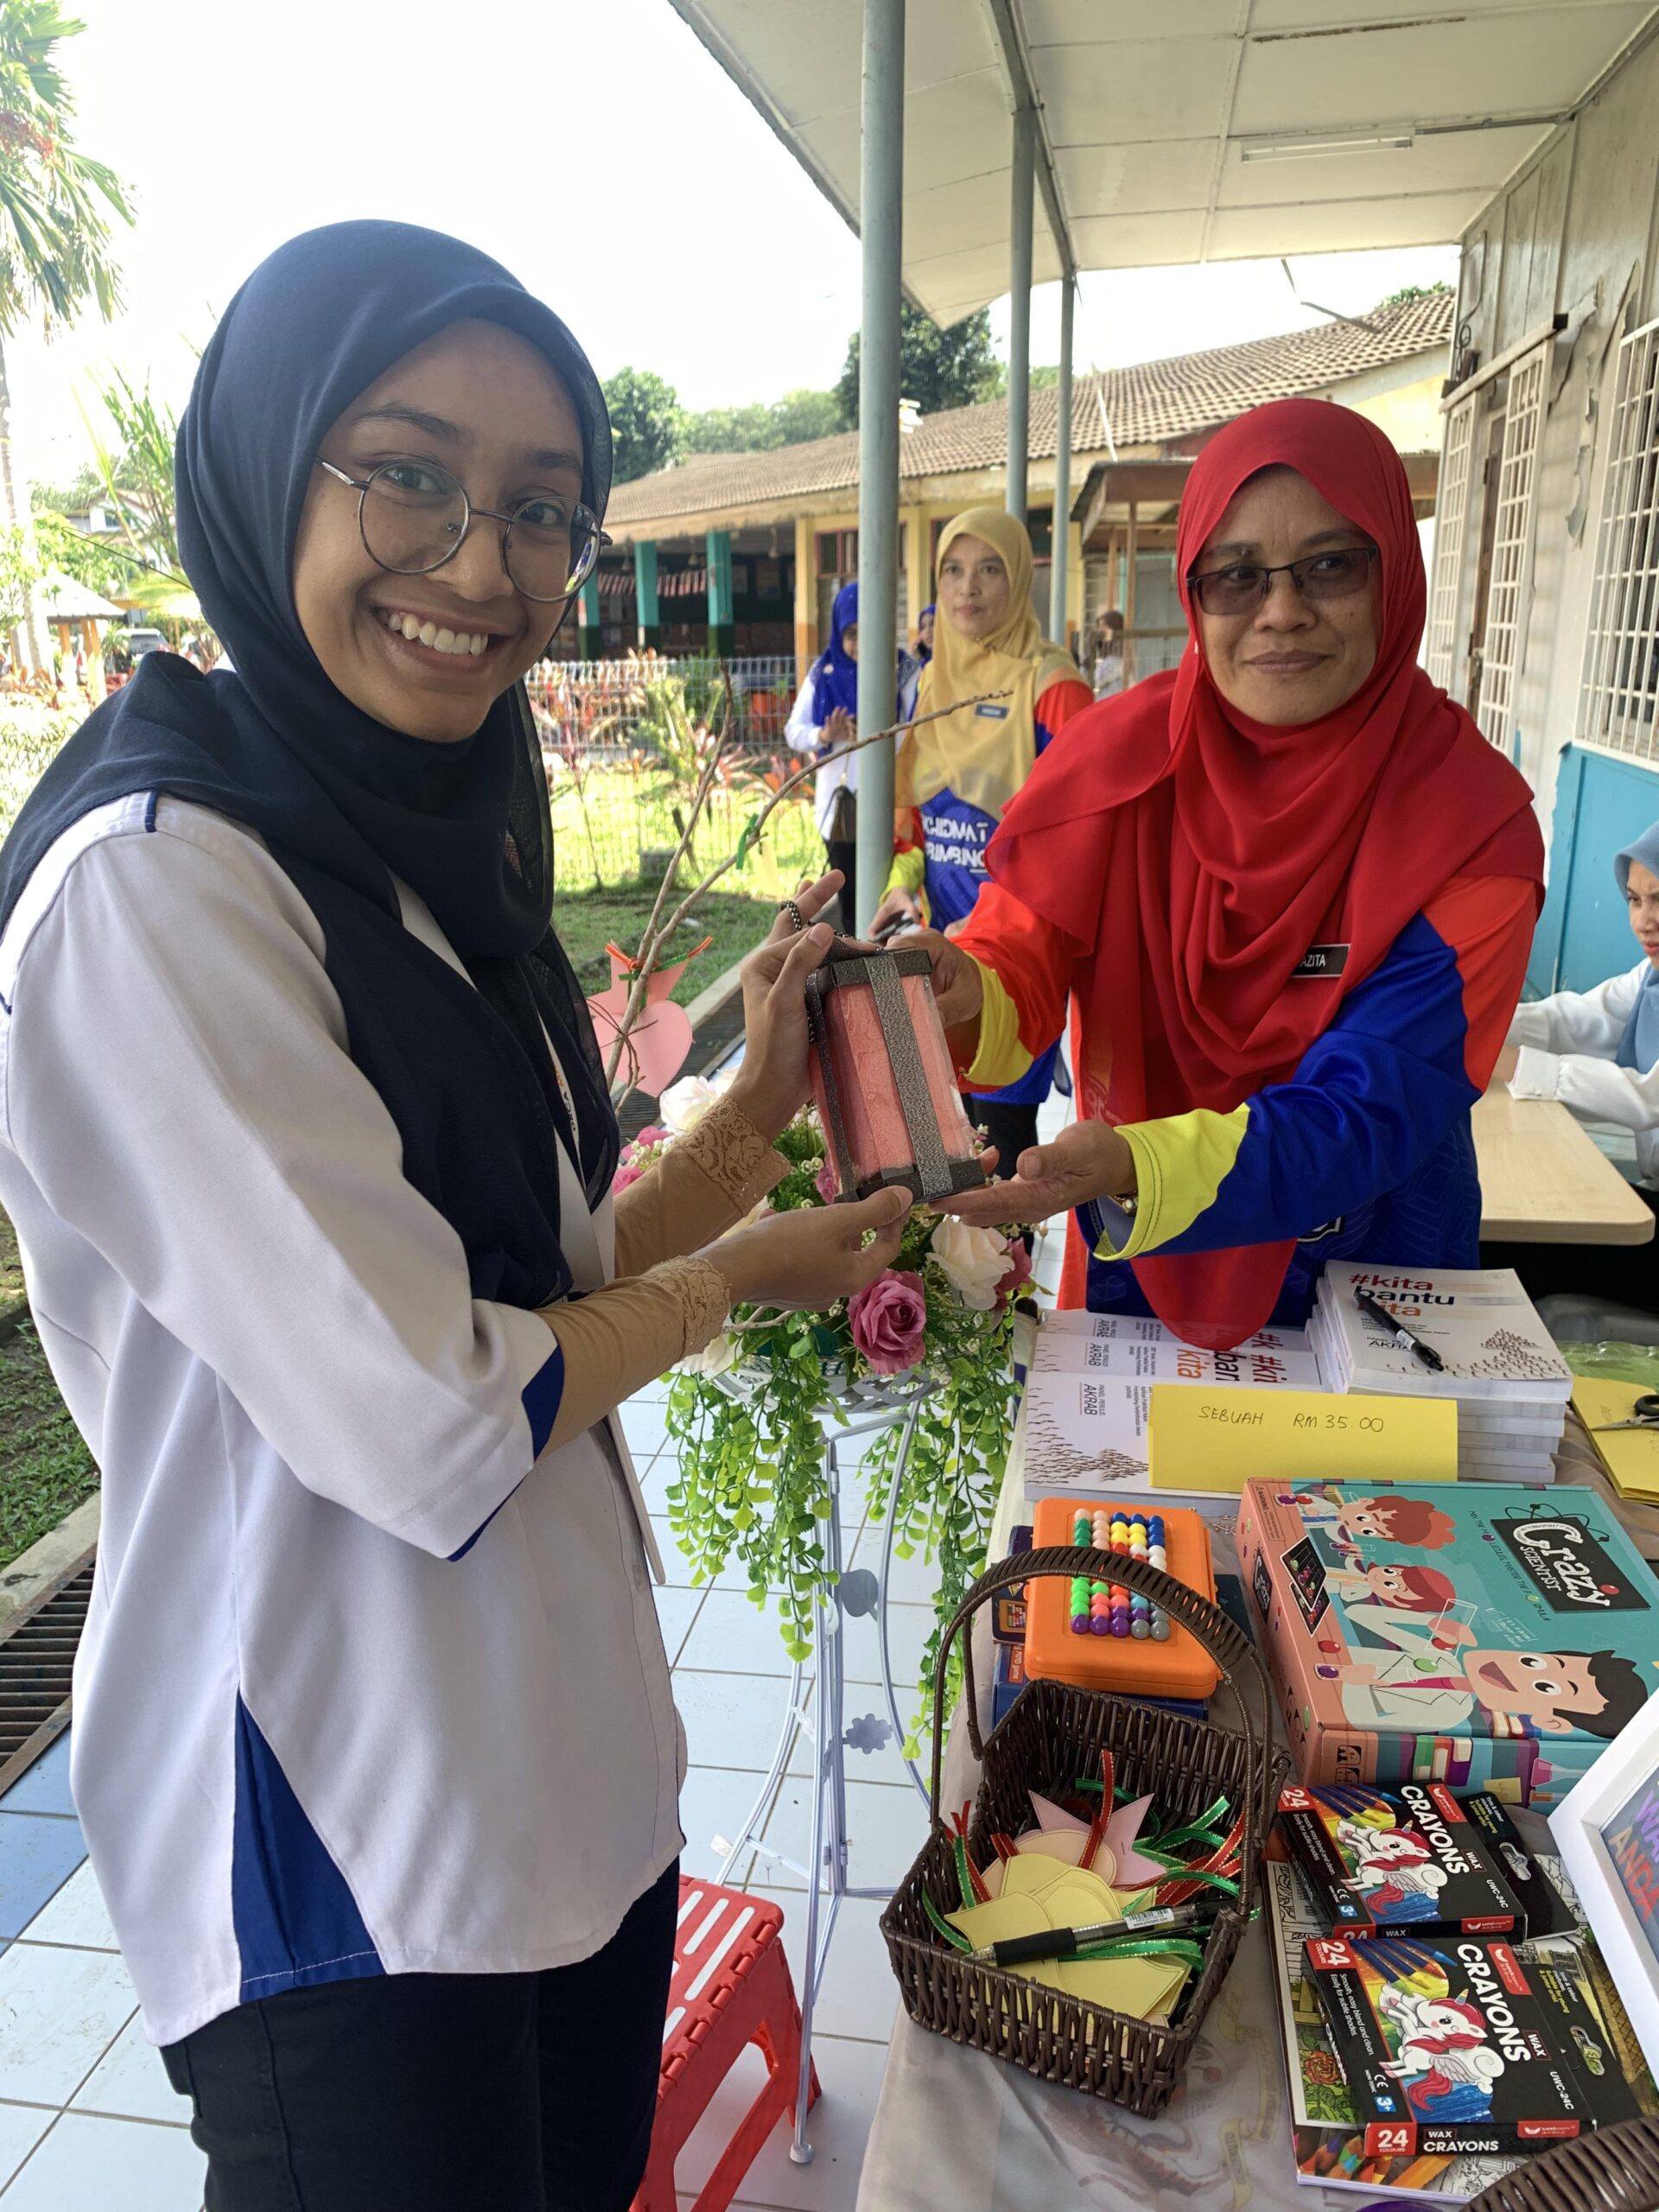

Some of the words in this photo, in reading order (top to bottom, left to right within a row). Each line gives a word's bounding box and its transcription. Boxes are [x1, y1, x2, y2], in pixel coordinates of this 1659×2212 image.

[1349, 1274, 1433, 1291] #kita
[1354, 1286, 1455, 1305] bantu
[1357, 1300, 1421, 1317] ita
[1089, 1343, 1103, 1367] AKRAB
[1177, 1349, 1211, 1379] kita
[1084, 1383, 1098, 1415] AKRAB
[1198, 1405, 1264, 1425] SEBUAH
[1293, 1413, 1318, 1428] RM
[1513, 1522, 1611, 1606] Crazy
[1520, 1546, 1562, 1592] SCIENTIST
[1283, 1789, 1310, 1808] 24
[1401, 1785, 1470, 1874] CRAYONS
[1465, 1852, 1483, 1870] WAX
[1486, 1879, 1509, 1909] UWC-24C
[1340, 1905, 1354, 1916] 3+
[1321, 1942, 1351, 1966] 24
[1348, 1996, 1357, 2009] easy
[1457, 1944, 1532, 2062] CRAYONS
[1353, 2009, 1365, 2026] blend
[1358, 2026, 1370, 2038] and
[1528, 2033, 1547, 2056] WAX
[1550, 2071, 1574, 2111] UWC-24C
[1376, 2096, 1392, 2113] 3+
[1377, 2129, 1409, 2148] 24
[1423, 2140, 1499, 2152] CRAYONS
